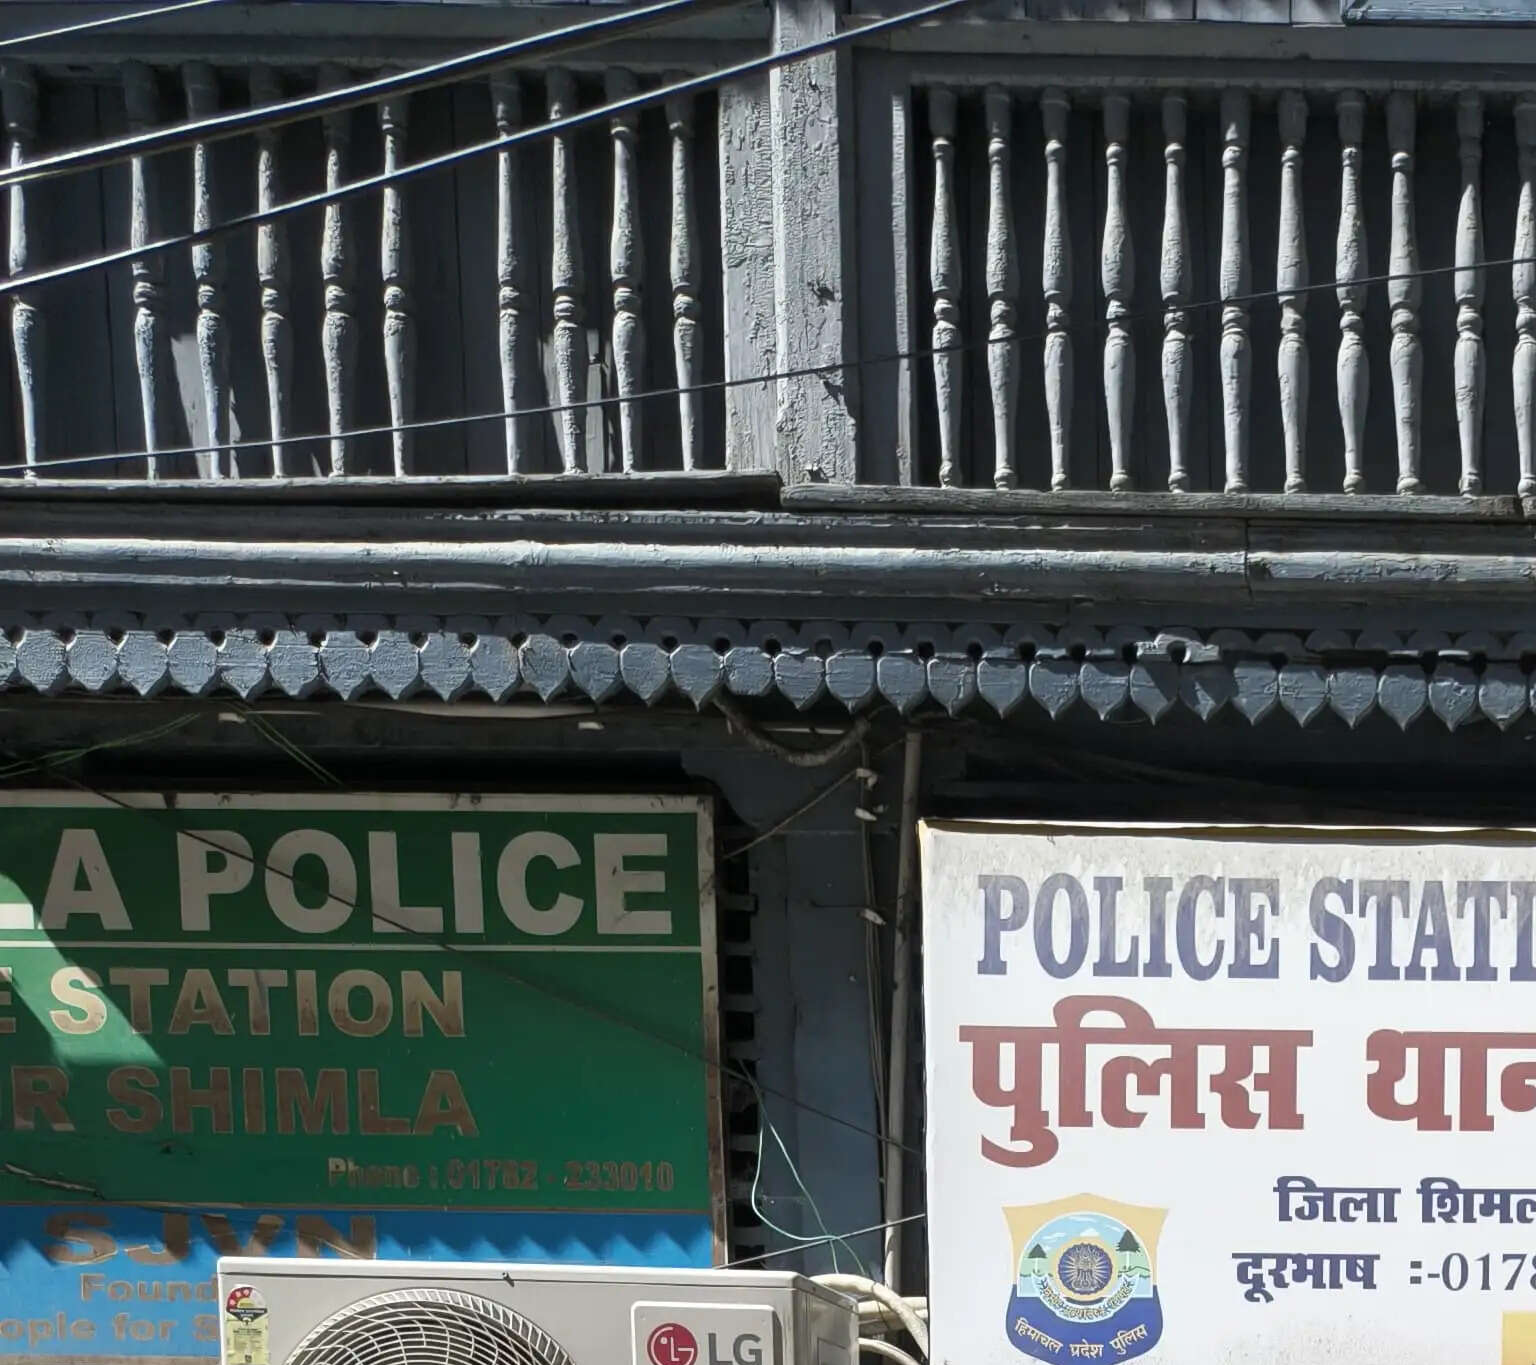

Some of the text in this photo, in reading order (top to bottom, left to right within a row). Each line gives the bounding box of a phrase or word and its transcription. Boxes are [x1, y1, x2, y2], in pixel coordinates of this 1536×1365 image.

[176, 829, 672, 934] POLICE
[977, 873, 1280, 980] POLICE
[50, 966, 465, 1038] STATION
[106, 1066, 479, 1136] SHIMLA
[959, 995, 1313, 1168] पुलिस
[328, 1157, 419, 1189] Phone
[448, 1159, 538, 1190] 01782
[564, 1160, 674, 1191] 233010
[1273, 1176, 1401, 1223] जिला
[1232, 1252, 1380, 1303] दूरभाष
[113, 1312, 178, 1340] for
[1014, 1317, 1149, 1359] हिमाचल प्रदेश पुलिस
